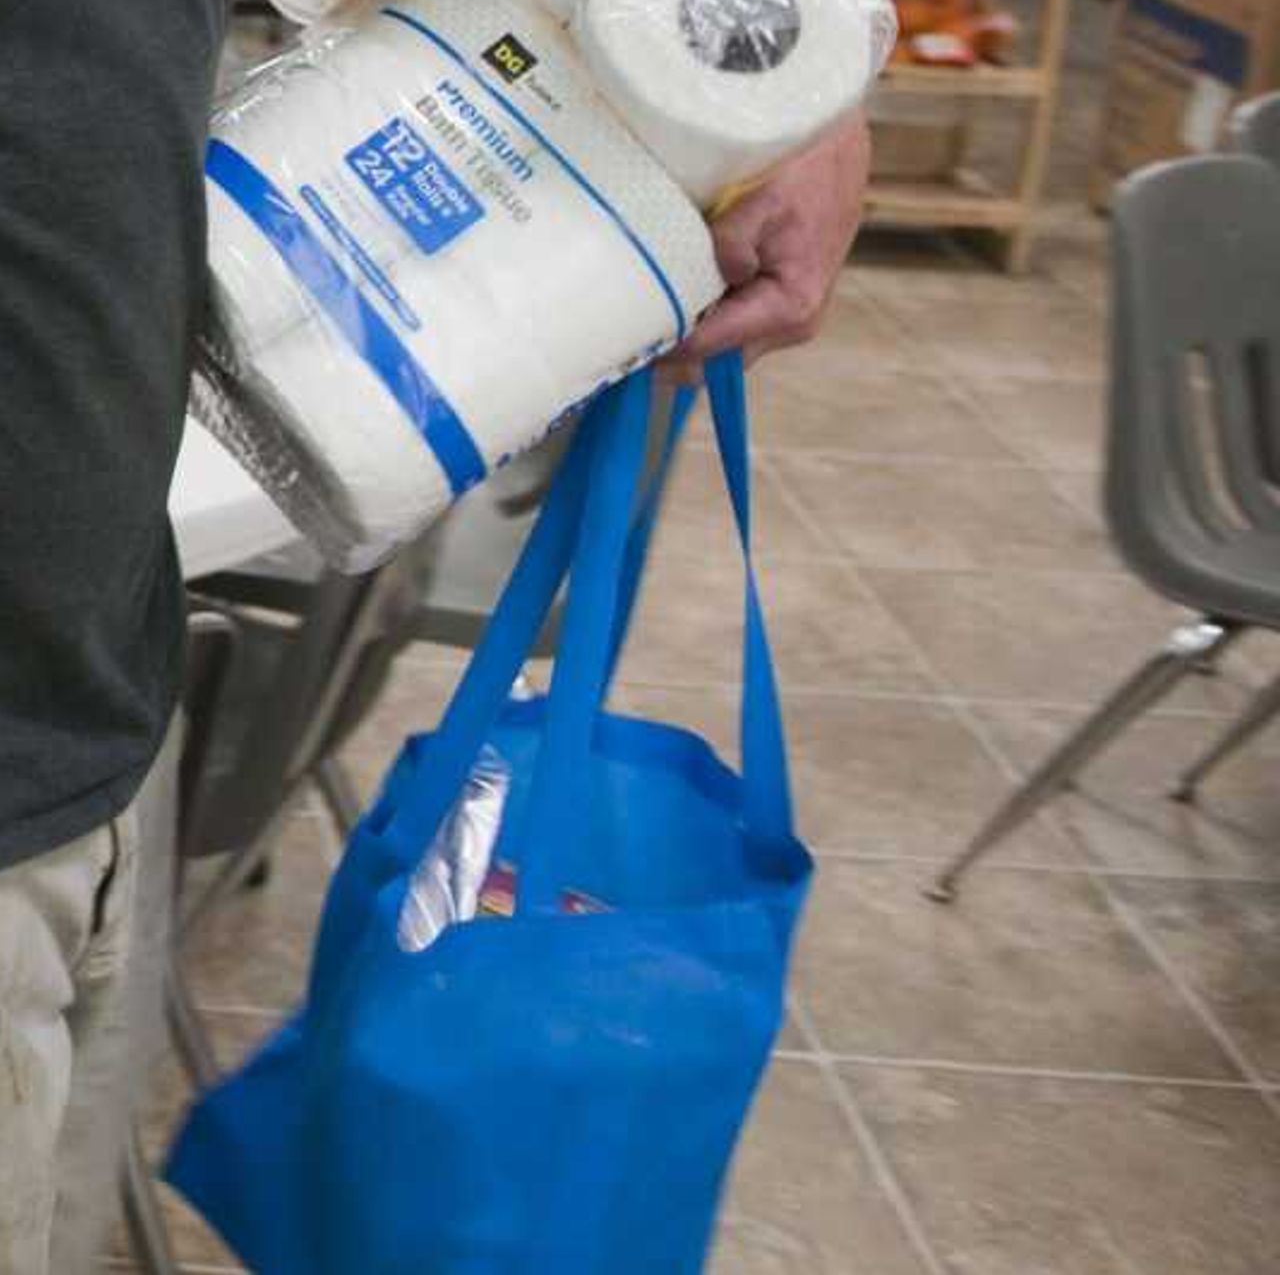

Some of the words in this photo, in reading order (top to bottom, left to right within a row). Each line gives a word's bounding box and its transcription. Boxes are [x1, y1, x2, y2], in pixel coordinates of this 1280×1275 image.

[353, 148, 396, 189] 24
[382, 124, 425, 172] 12
[416, 94, 467, 153] Bath
[465, 149, 533, 223] Tissue
[437, 80, 534, 183] Premium
